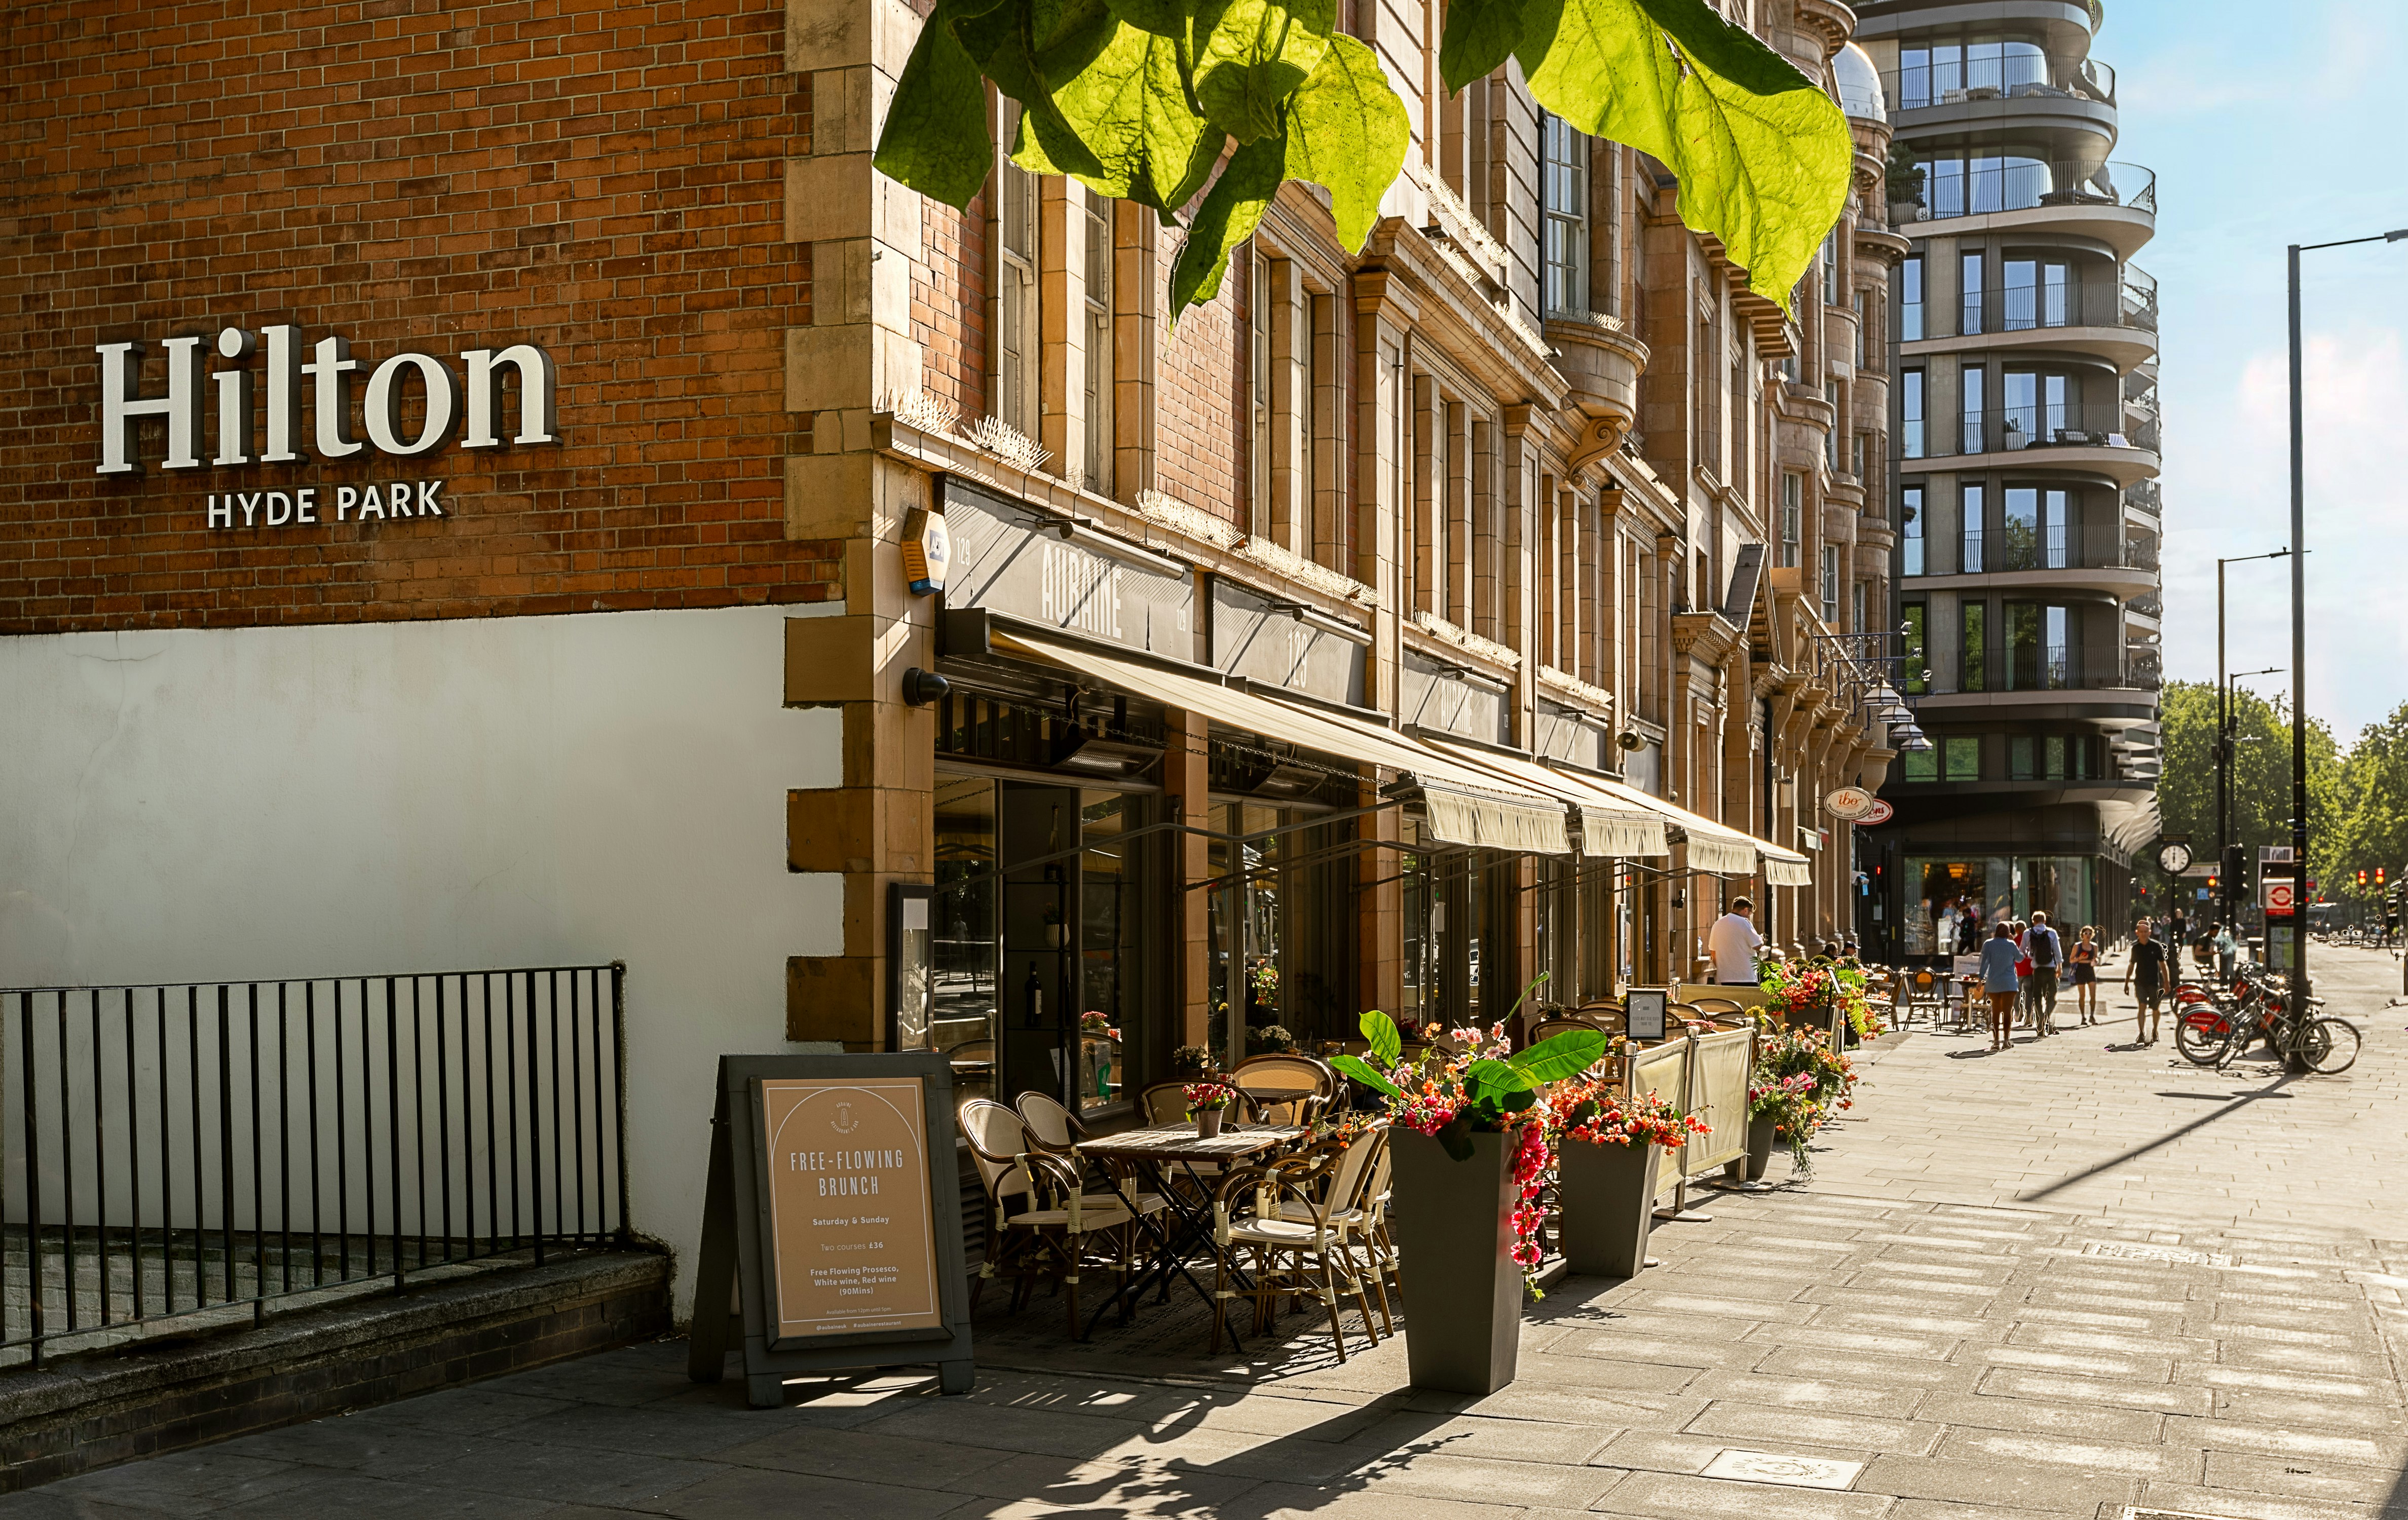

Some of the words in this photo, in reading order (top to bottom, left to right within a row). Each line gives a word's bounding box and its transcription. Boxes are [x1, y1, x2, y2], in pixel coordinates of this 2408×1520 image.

[96, 324, 560, 474] Hilton
[208, 488, 315, 528] HYDE
[337, 481, 443, 521] PARK
[929, 536, 944, 557] ADT
[956, 536, 970, 566] 129
[1041, 543, 1122, 639] AUBAINE
[1176, 608, 1186, 632] 129
[1288, 629, 1308, 688] 129
[1838, 791, 1863, 806] ibo
[1827, 803, 1842, 816] BREAKFAST
[1858, 805, 1869, 815] DINNER
[831, 1120, 850, 1133] RESTAURANT
[791, 1149, 903, 1171] FREE-FLOWING
[819, 1176, 879, 1196] BRUNCH
[813, 1218, 849, 1226] Saturday
[860, 1216, 889, 1225] Sunday
[830, 1267, 860, 1275] Flowing
[839, 1287, 873, 1296] (90Mins)
